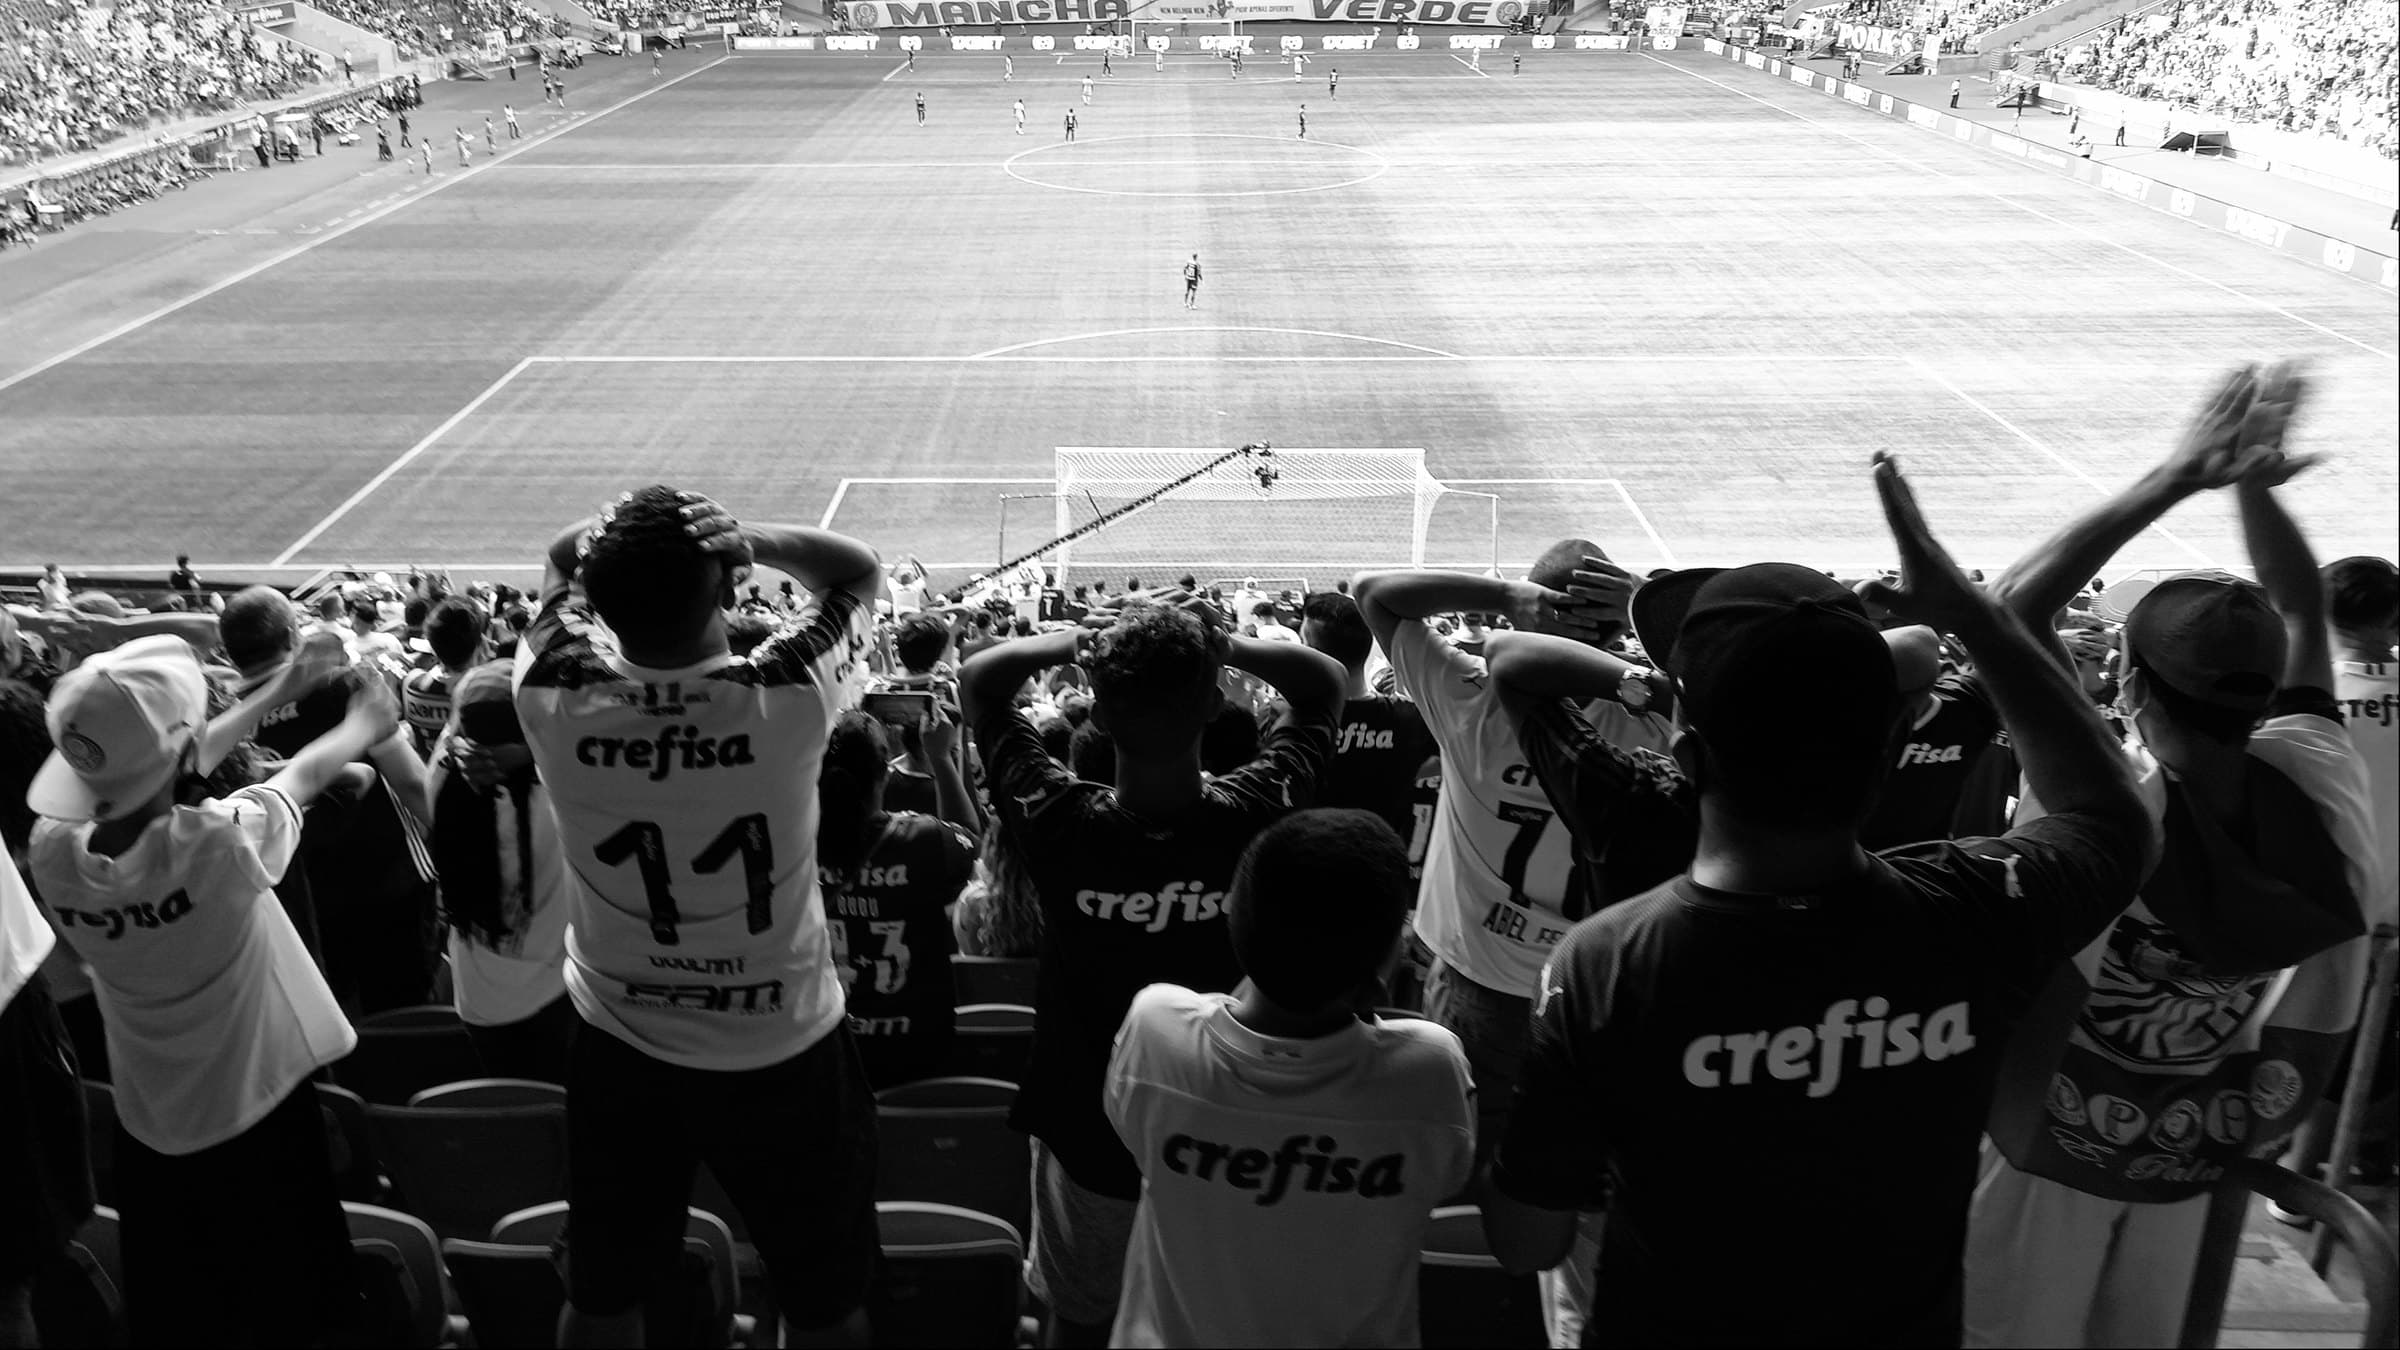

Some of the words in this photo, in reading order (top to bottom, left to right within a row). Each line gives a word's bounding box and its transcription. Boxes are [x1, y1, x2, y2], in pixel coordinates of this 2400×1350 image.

[887, 0, 1128, 25] MANCHA
[1313, 0, 1492, 24] VERDE
[576, 724, 755, 782] crefisa
[1896, 742, 1963, 769] fisa
[594, 812, 774, 946] 11
[1482, 901, 1528, 942] ABEL
[1682, 996, 1976, 1099] crefisa
[1162, 1133, 1407, 1206] crefisa
